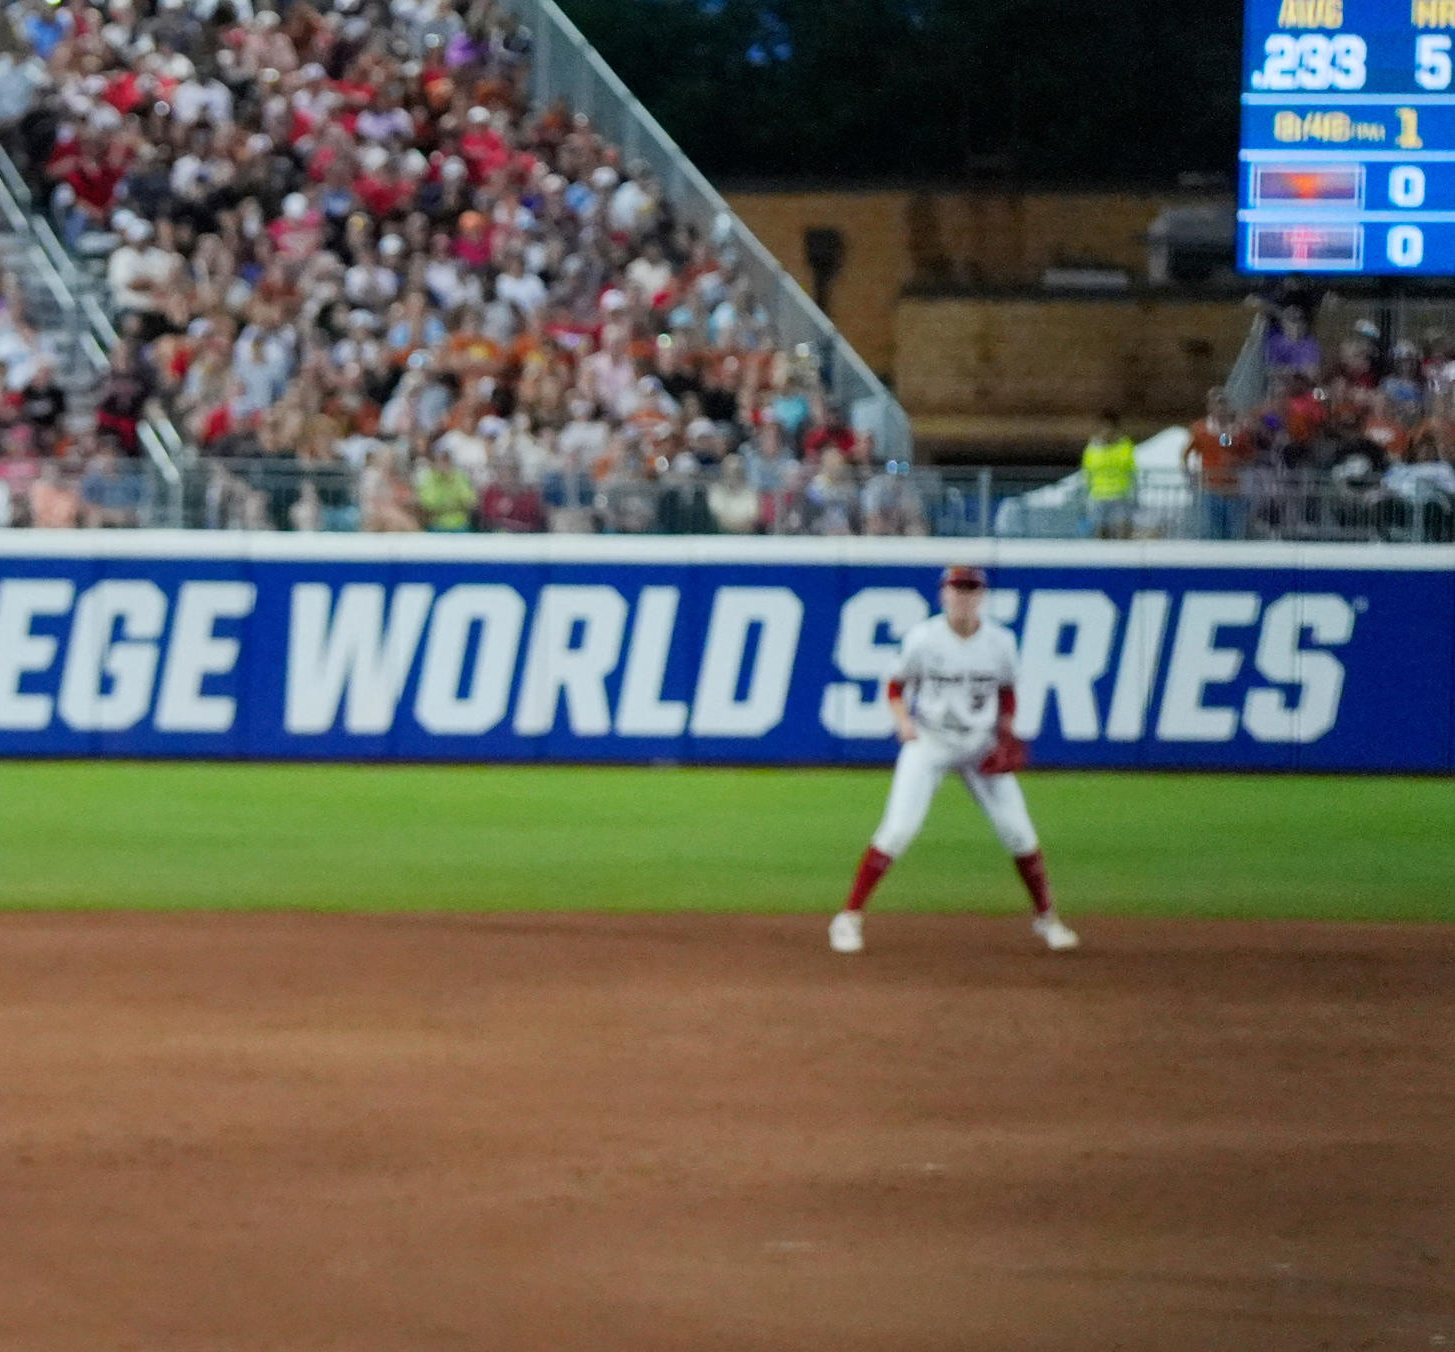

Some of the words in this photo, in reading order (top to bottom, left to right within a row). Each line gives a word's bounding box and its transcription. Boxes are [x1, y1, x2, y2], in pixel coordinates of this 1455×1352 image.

[1251, 33, 1367, 90] .233
[1415, 33, 1452, 91] 5
[1395, 107, 1423, 149] 1
[1389, 165, 1426, 208] 0
[1386, 225, 1424, 267] 0
[283, 581, 805, 738] WORLD
